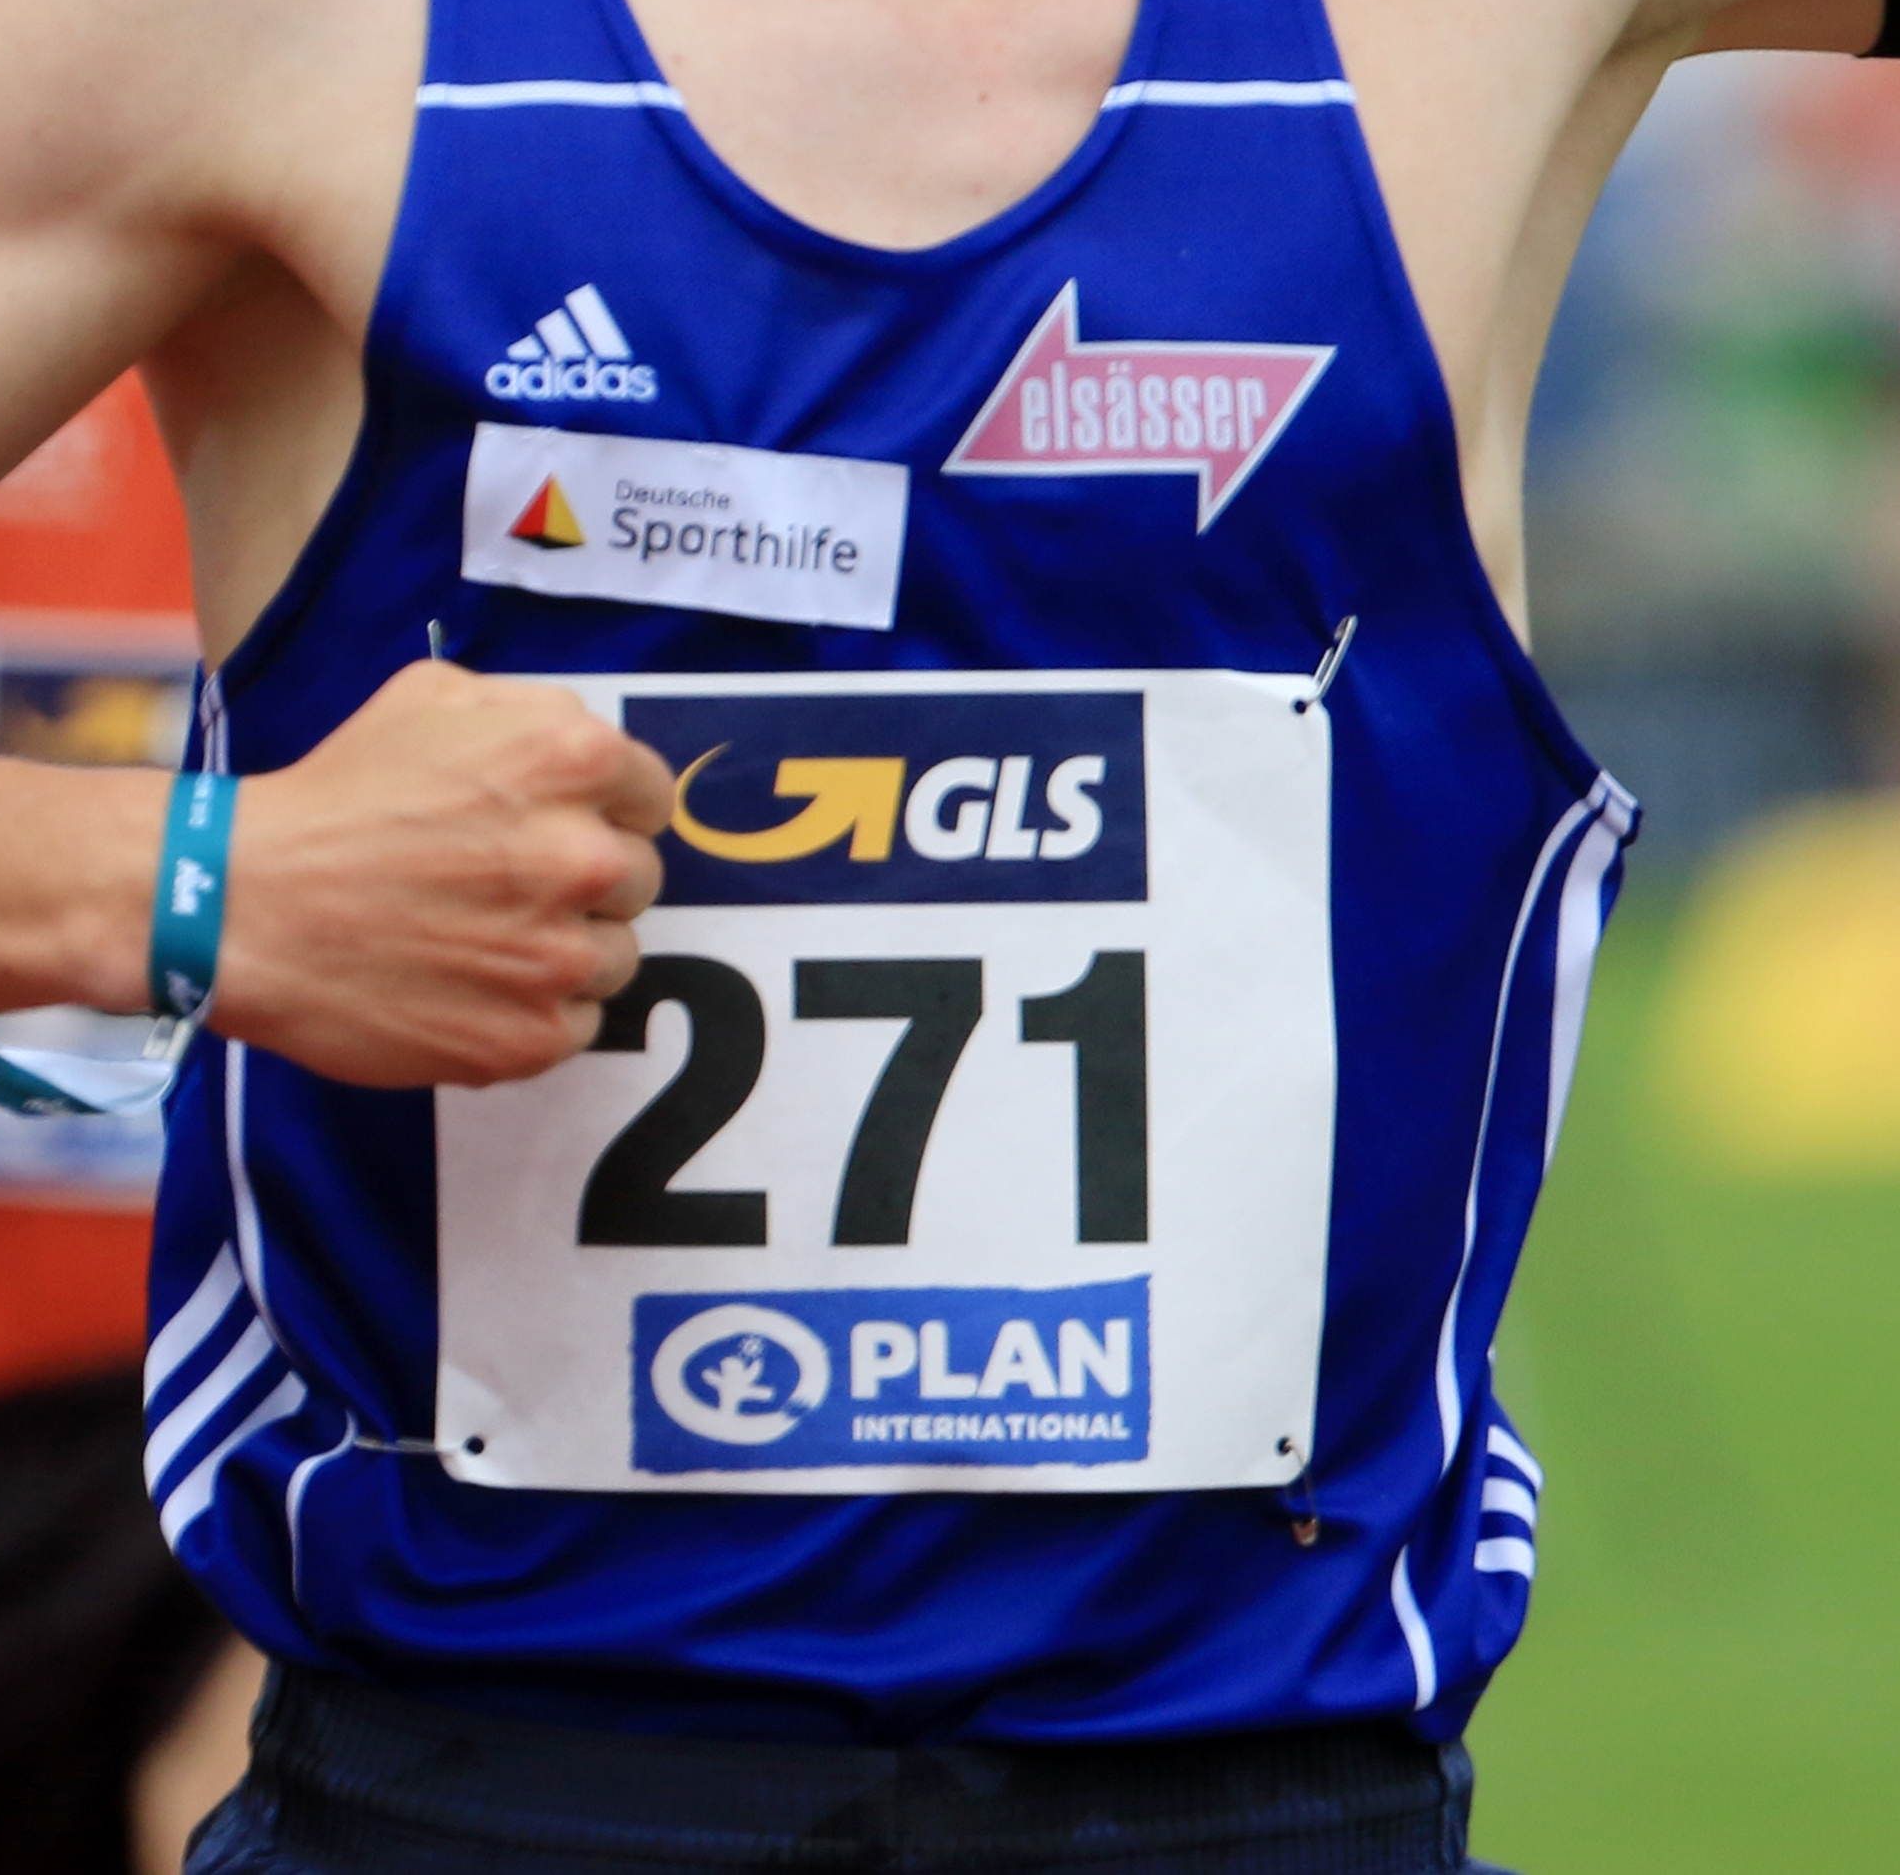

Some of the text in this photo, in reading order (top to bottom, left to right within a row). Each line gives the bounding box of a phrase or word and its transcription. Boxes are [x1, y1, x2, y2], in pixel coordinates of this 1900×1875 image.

[485, 357, 658, 400] adidas
[1021, 361, 1266, 452] elsässer
[614, 479, 731, 510] Deutsche
[609, 507, 859, 574] Sporthilfe
[904, 755, 1105, 862] GLS
[577, 949, 1150, 1247] 271
[849, 1318, 1133, 1400] PLAN
[851, 1411, 1131, 1442] INTERNATIONAL
